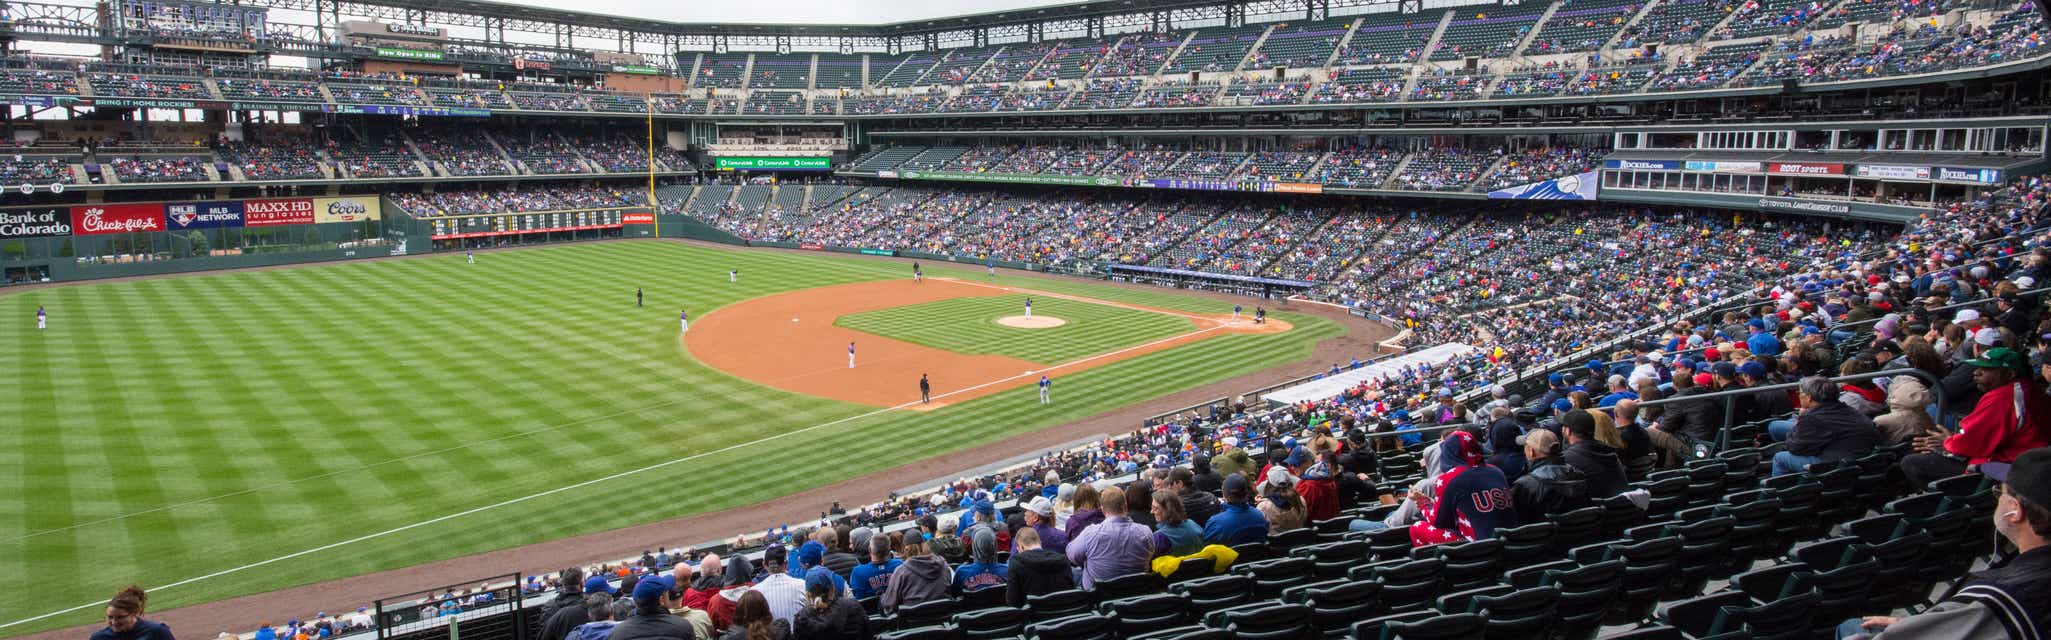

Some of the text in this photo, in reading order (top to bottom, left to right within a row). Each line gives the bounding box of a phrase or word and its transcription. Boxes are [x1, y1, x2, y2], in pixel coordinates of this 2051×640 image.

[1620, 160, 1664, 169] ROCKIES.com
[1780, 164, 1801, 172] ROOT
[247, 201, 312, 213] MAXX HD
[328, 201, 366, 214] Coors
[1769, 200, 1791, 208] TOYOTA
[1830, 205, 1849, 213] CLUB
[0, 210, 55, 224] Bank of
[83, 209, 158, 231] Chick-fil-A
[197, 213, 240, 222] NETWORK
[247, 211, 312, 219] sunglasses
[0, 222, 70, 236] Colorado
